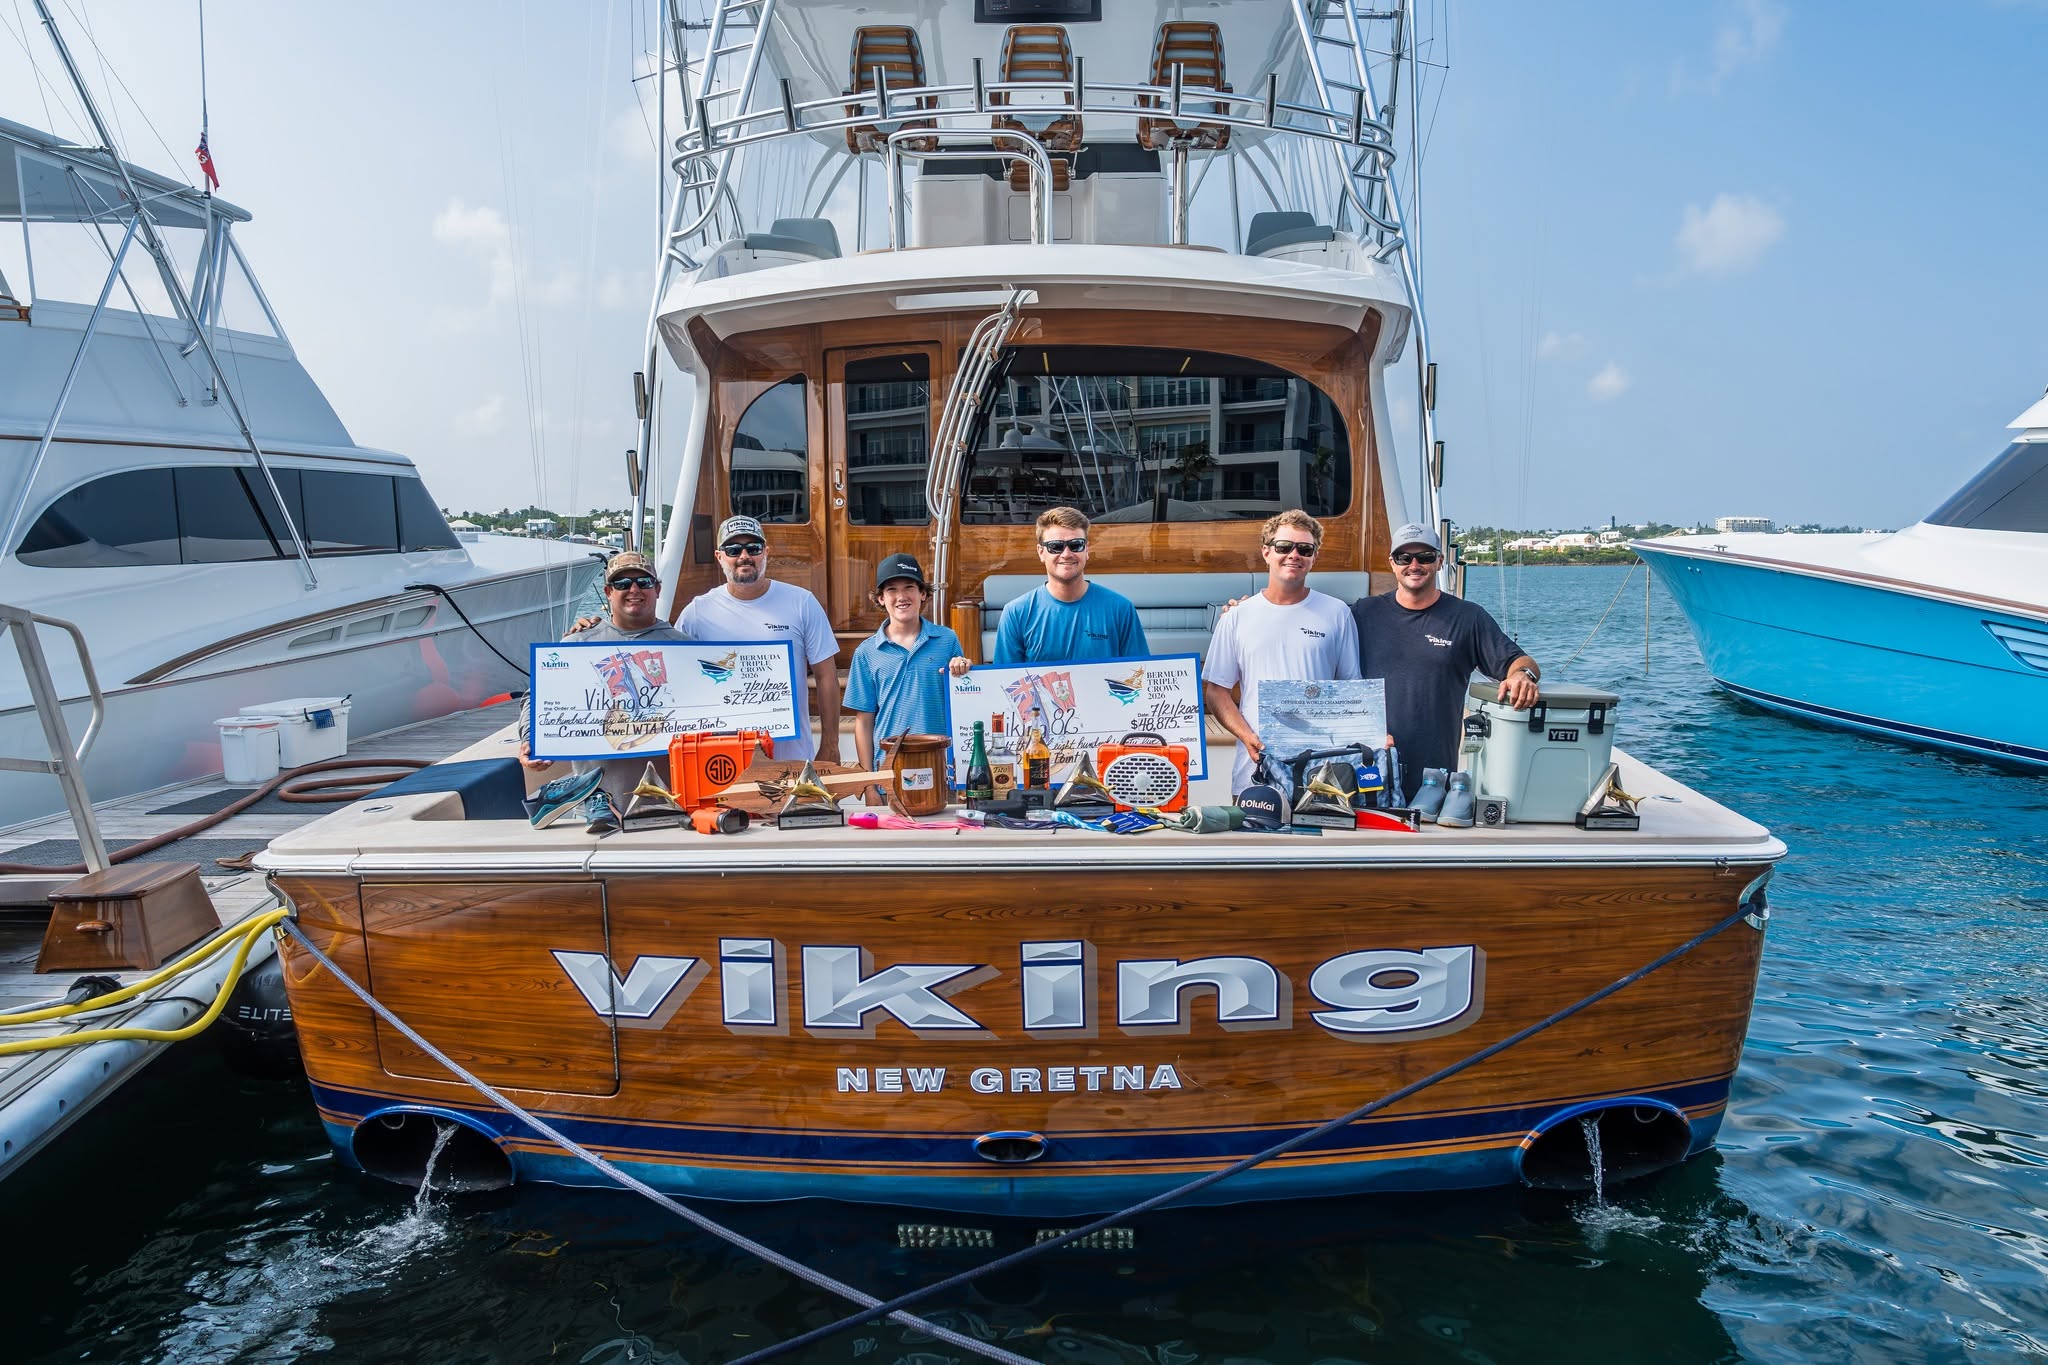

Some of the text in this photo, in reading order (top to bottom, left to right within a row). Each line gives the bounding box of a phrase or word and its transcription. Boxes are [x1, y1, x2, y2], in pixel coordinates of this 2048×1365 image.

[1146, 670, 1188, 679] BERMUDA
[1147, 677, 1178, 686] TRIPLE
[585, 686, 663, 712] Viking 82
[1147, 685, 1180, 693] CROWN
[559, 717, 728, 738] Crown Jewel WTA Release Points
[1051, 707, 1079, 736] 82
[1550, 730, 1577, 741] YETI
[709, 759, 733, 781] SIG
[1245, 799, 1275, 812] OluKai
[549, 937, 1484, 1038] viking
[836, 1064, 1183, 1094] NEW GRETNA
